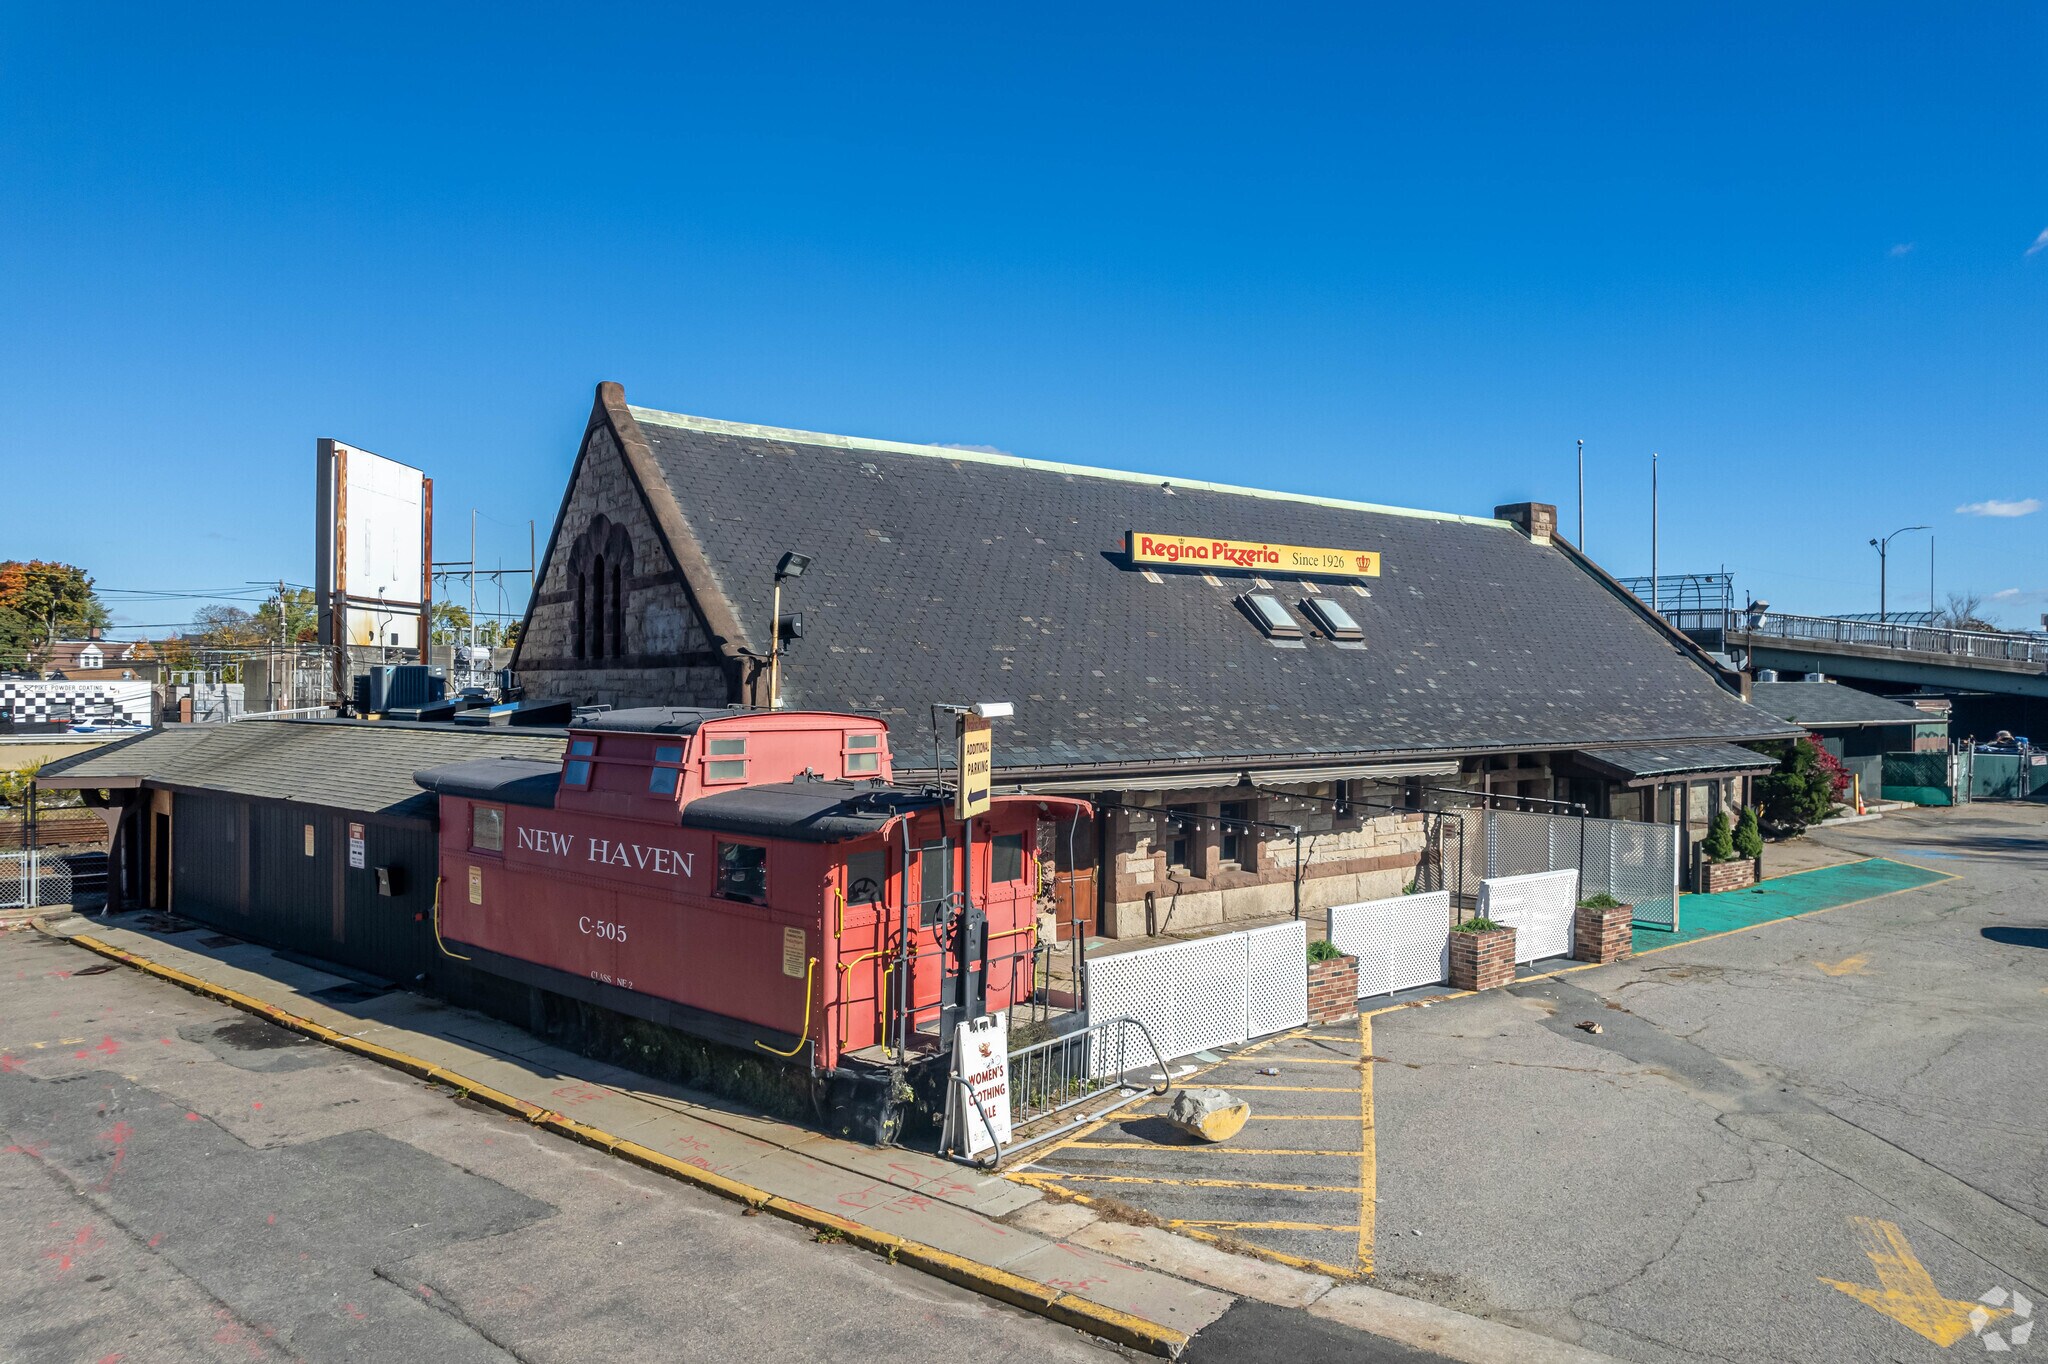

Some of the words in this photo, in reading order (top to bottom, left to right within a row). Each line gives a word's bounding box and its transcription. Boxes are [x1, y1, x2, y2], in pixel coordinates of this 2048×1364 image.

[1142, 537, 1208, 561] Regina
[1212, 542, 1279, 567] Pizzeria
[1292, 552, 1319, 567] Since
[1322, 554, 1345, 569] 1926
[966, 742, 989, 755] ADDITIONAL
[968, 760, 988, 776] PARKING
[517, 826, 574, 857] NEW
[588, 838, 695, 878] HAVEN
[579, 916, 627, 942] C-505
[969, 1065, 1003, 1086] WOMEN'S
[969, 1083, 1005, 1106] COTHING
[980, 1105, 996, 1121] ALE
